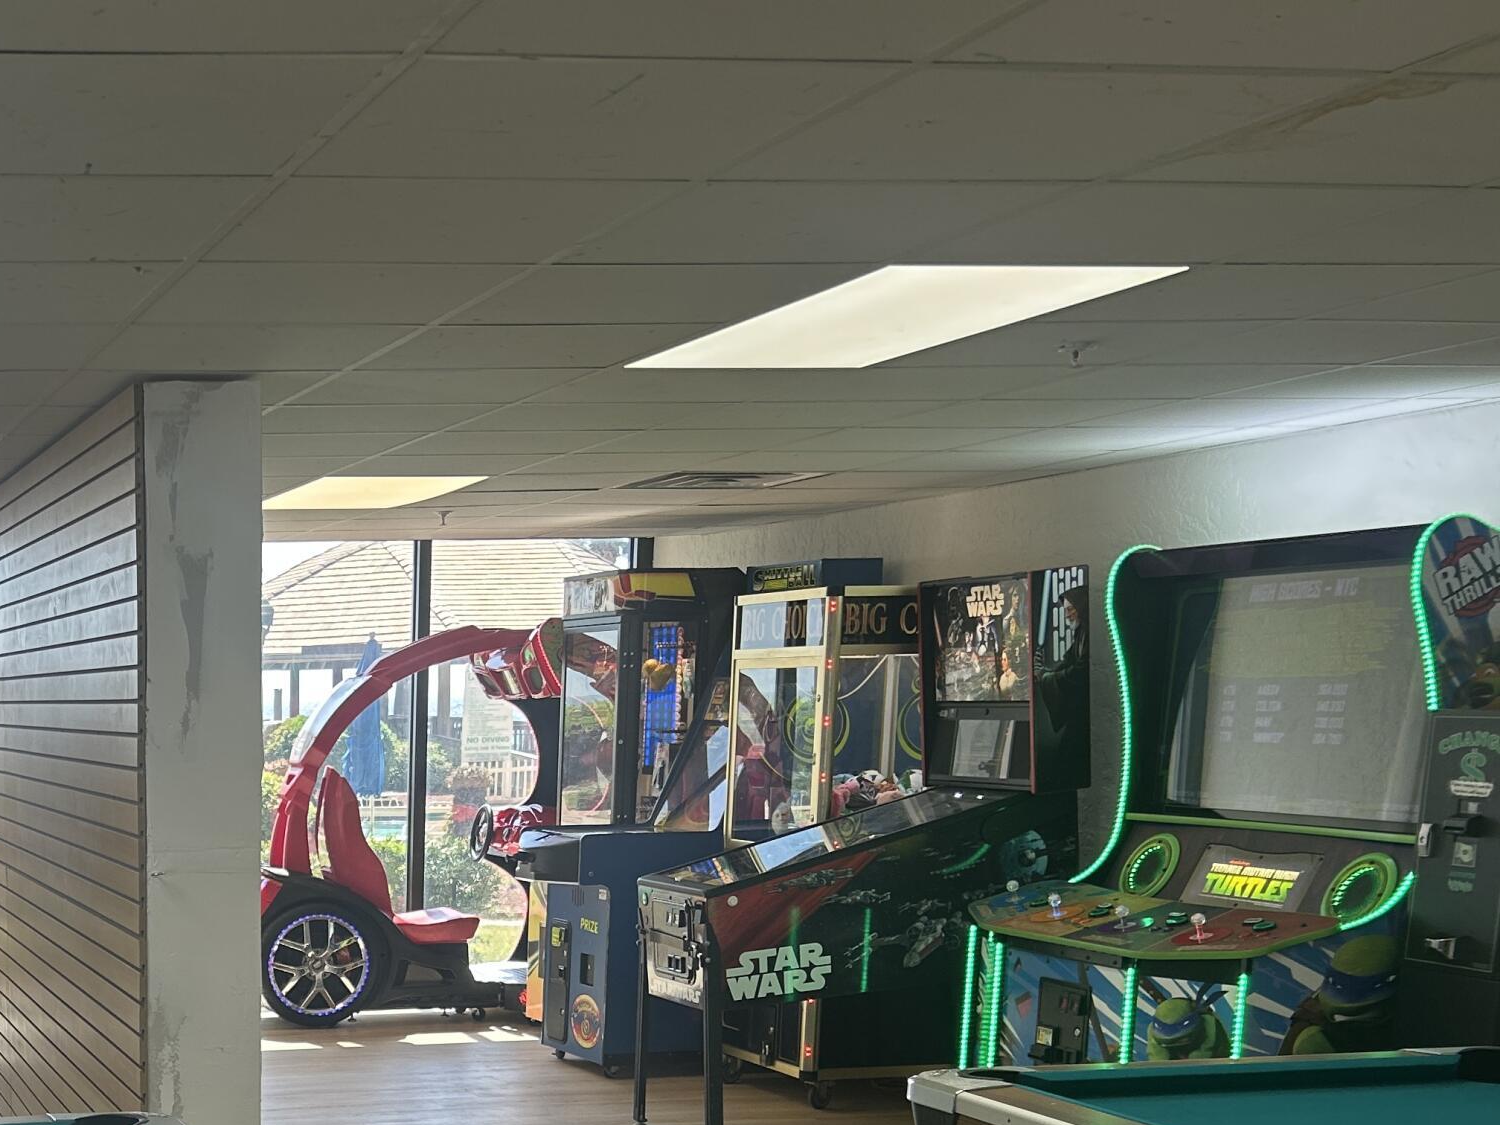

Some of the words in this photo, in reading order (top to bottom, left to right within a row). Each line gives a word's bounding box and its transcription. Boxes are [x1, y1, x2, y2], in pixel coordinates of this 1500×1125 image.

[1434, 535, 1500, 600] RAW
[966, 583, 1004, 602] STAR
[1277, 580, 1323, 600] SCORES
[745, 606, 766, 641] BIG
[846, 600, 888, 635] BIG
[966, 600, 1004, 618] WARS
[467, 736, 479, 745] NO
[481, 735, 510, 745] DIVING
[1201, 872, 1295, 903] TURTLES
[580, 918, 599, 934] PRIZE
[726, 942, 832, 978] STAR
[726, 965, 832, 1001] WARS
